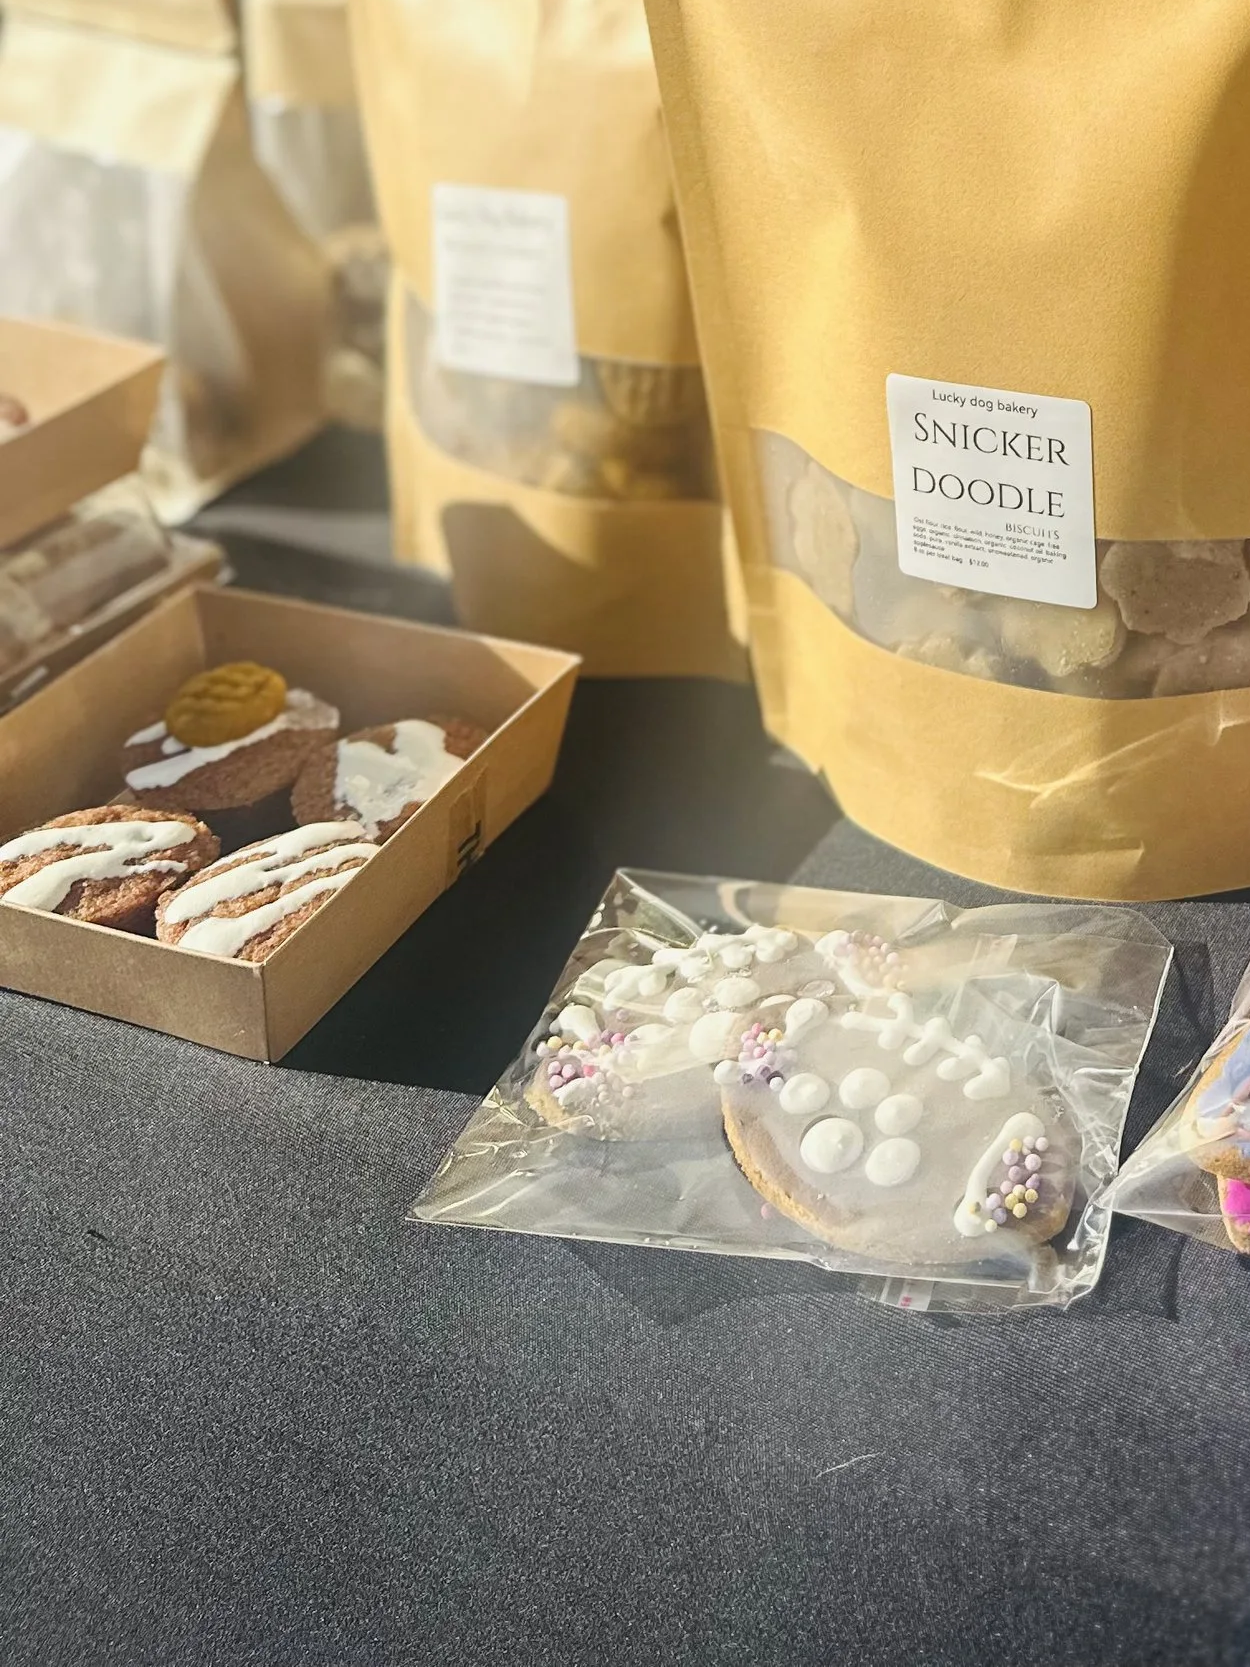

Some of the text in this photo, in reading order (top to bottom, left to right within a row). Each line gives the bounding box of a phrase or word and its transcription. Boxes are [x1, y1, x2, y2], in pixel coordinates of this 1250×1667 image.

[933, 390, 1037, 418] Lucky dog bakery
[914, 413, 1070, 466] SNICKER
[912, 466, 1065, 518] DOODLE
[1005, 523, 1059, 539] BISCUITS
